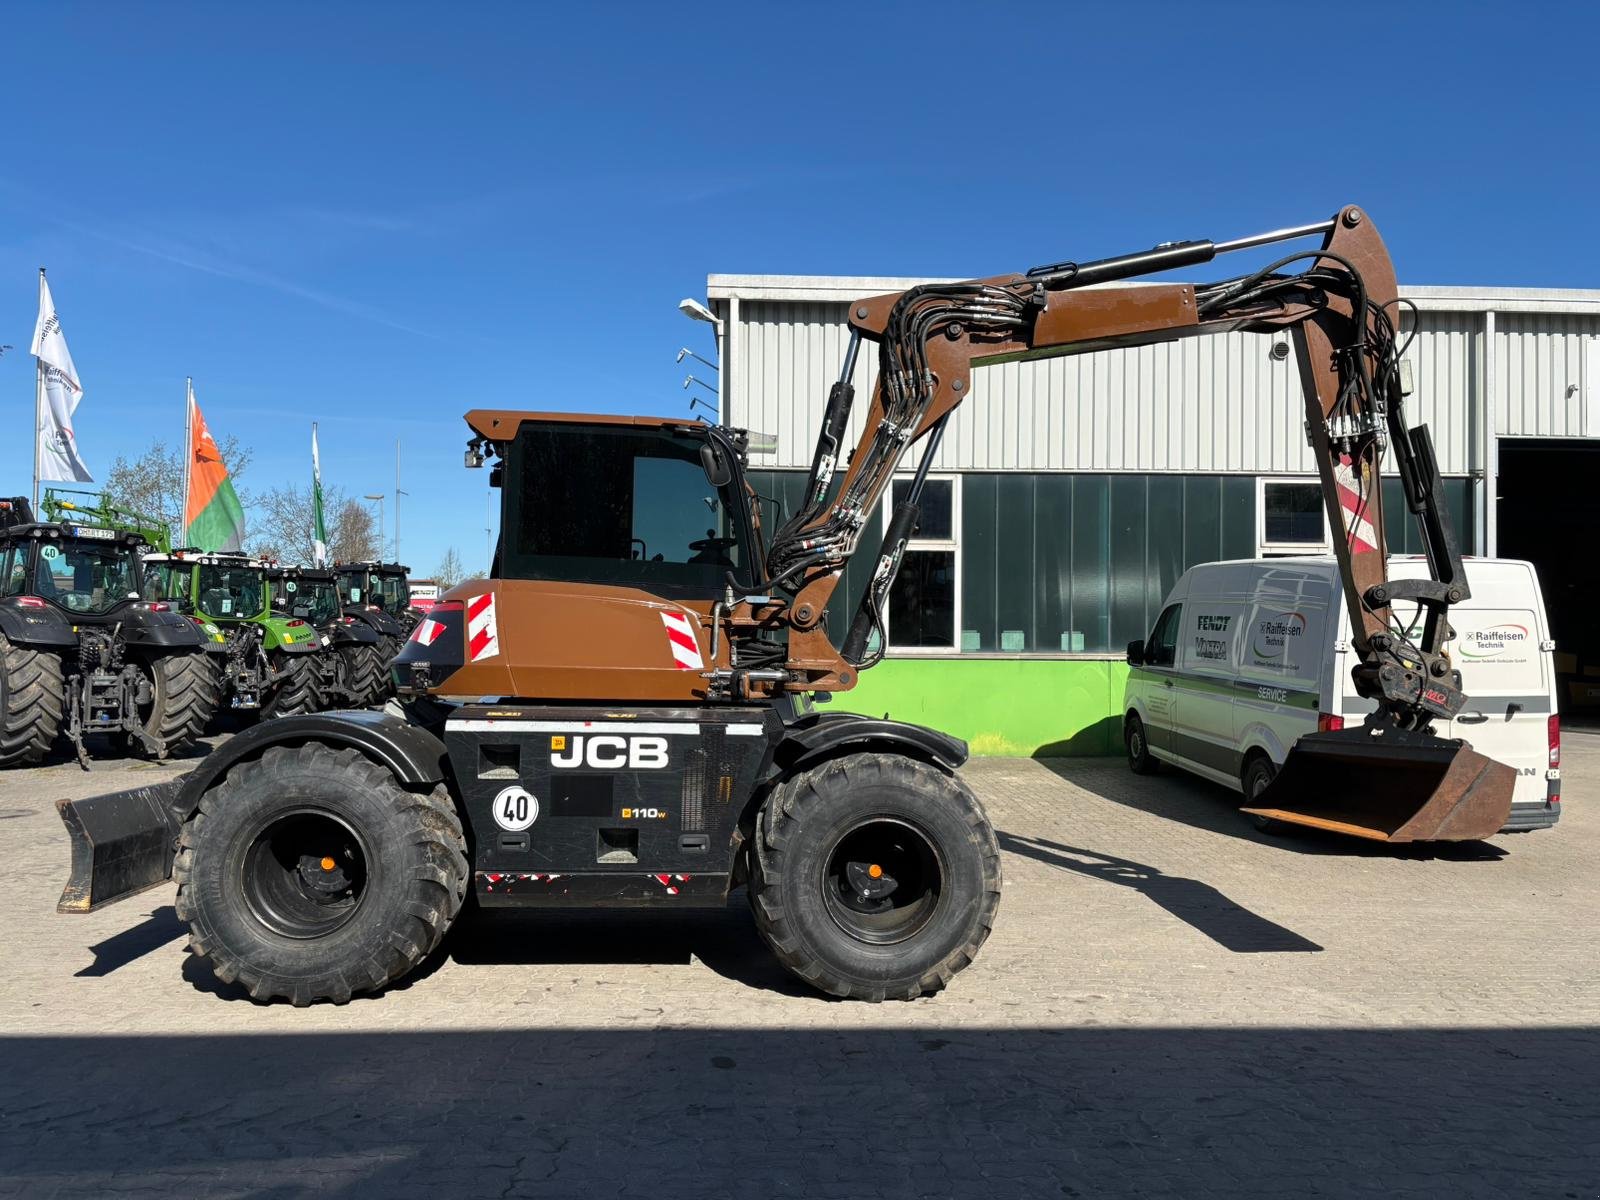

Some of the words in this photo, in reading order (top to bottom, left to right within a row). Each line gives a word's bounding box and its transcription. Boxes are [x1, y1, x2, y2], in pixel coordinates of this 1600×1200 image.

[44, 548, 56, 558] 40
[1198, 615, 1231, 631] FENDT
[1265, 621, 1301, 636] Raiffeisen
[1476, 631, 1523, 640] Raiffeisen
[1258, 686, 1287, 702] SERVICE
[551, 736, 669, 769] JCB
[1517, 768, 1536, 776] AN
[503, 795, 528, 821] 40
